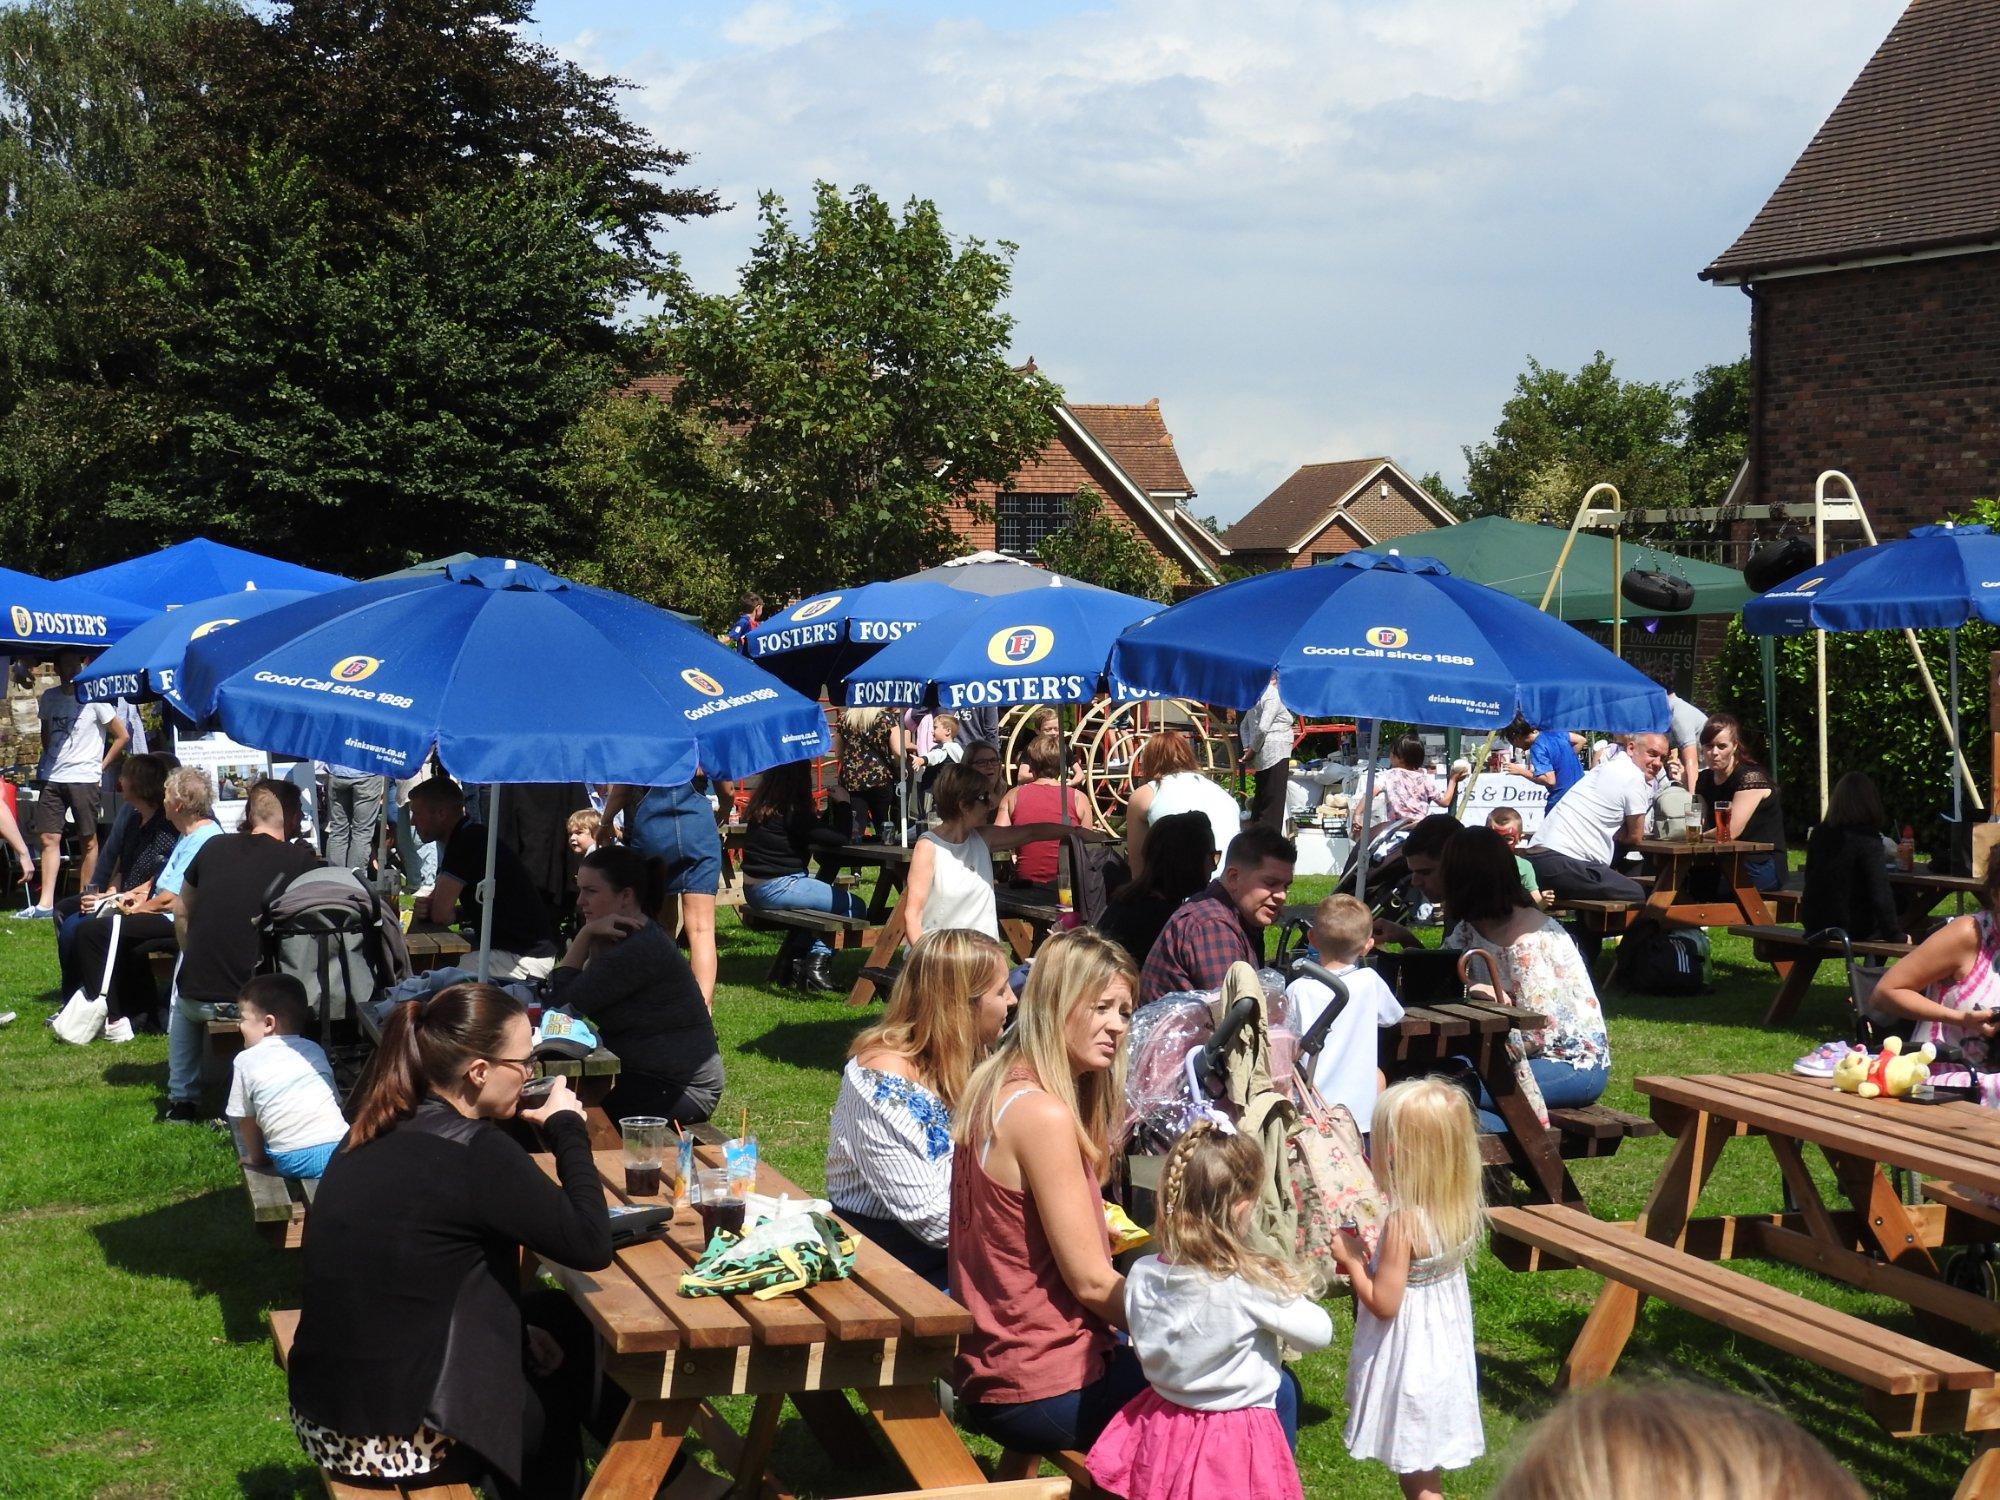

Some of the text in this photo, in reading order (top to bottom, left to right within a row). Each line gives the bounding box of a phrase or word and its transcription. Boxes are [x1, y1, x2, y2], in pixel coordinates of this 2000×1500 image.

[33, 611, 107, 636] FOSTER'S
[859, 621, 921, 640] FOST
[757, 621, 837, 655] FOSTER'S
[1008, 635, 1034, 655] F
[1302, 646, 1475, 666] Good Call since 1888
[84, 673, 139, 701] FOSTER'S
[254, 671, 414, 709] Good Call since 1888
[853, 680, 922, 705] FOSTER'S
[949, 675, 1082, 708] FOSTER'S
[683, 703, 714, 720] Good
[707, 698, 732, 711] Call
[1428, 694, 1500, 709] drinkaware.co.uk
[344, 737, 407, 759] drinkaware.co.uk
[1481, 786, 1498, 802] &
[1502, 786, 1550, 801] Deme
